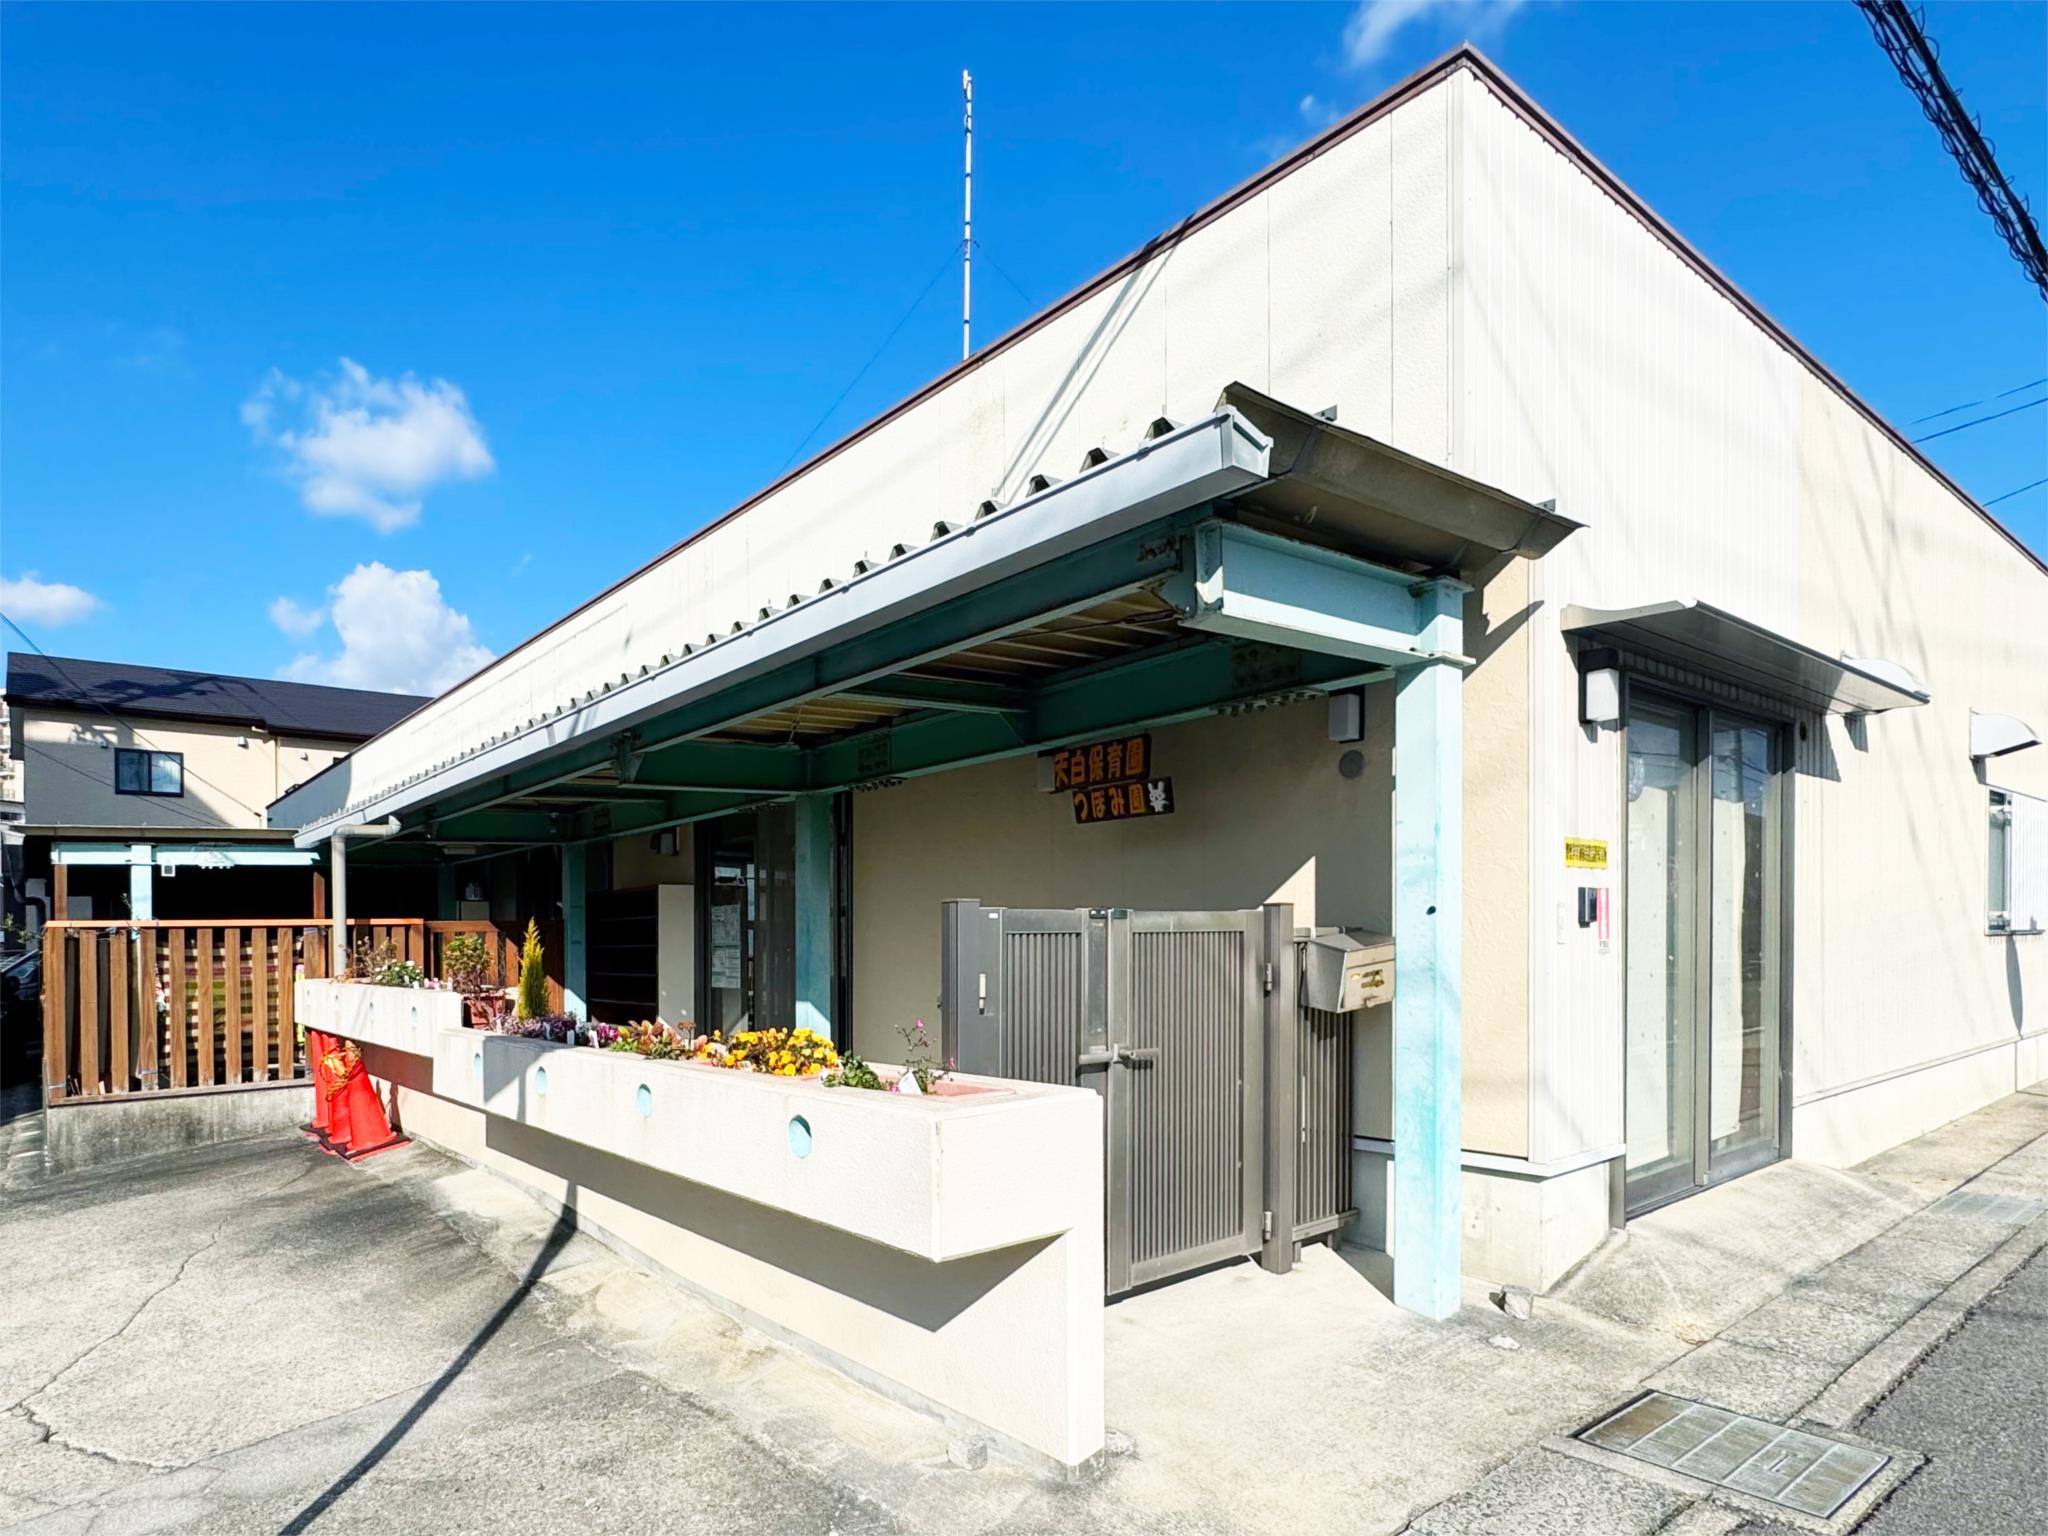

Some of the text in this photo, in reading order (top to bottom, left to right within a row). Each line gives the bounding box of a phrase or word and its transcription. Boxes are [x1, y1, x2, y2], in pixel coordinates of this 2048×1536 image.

[1055, 738, 1144, 786] 天白保育園
[1074, 783, 1146, 821] つぼみ園
